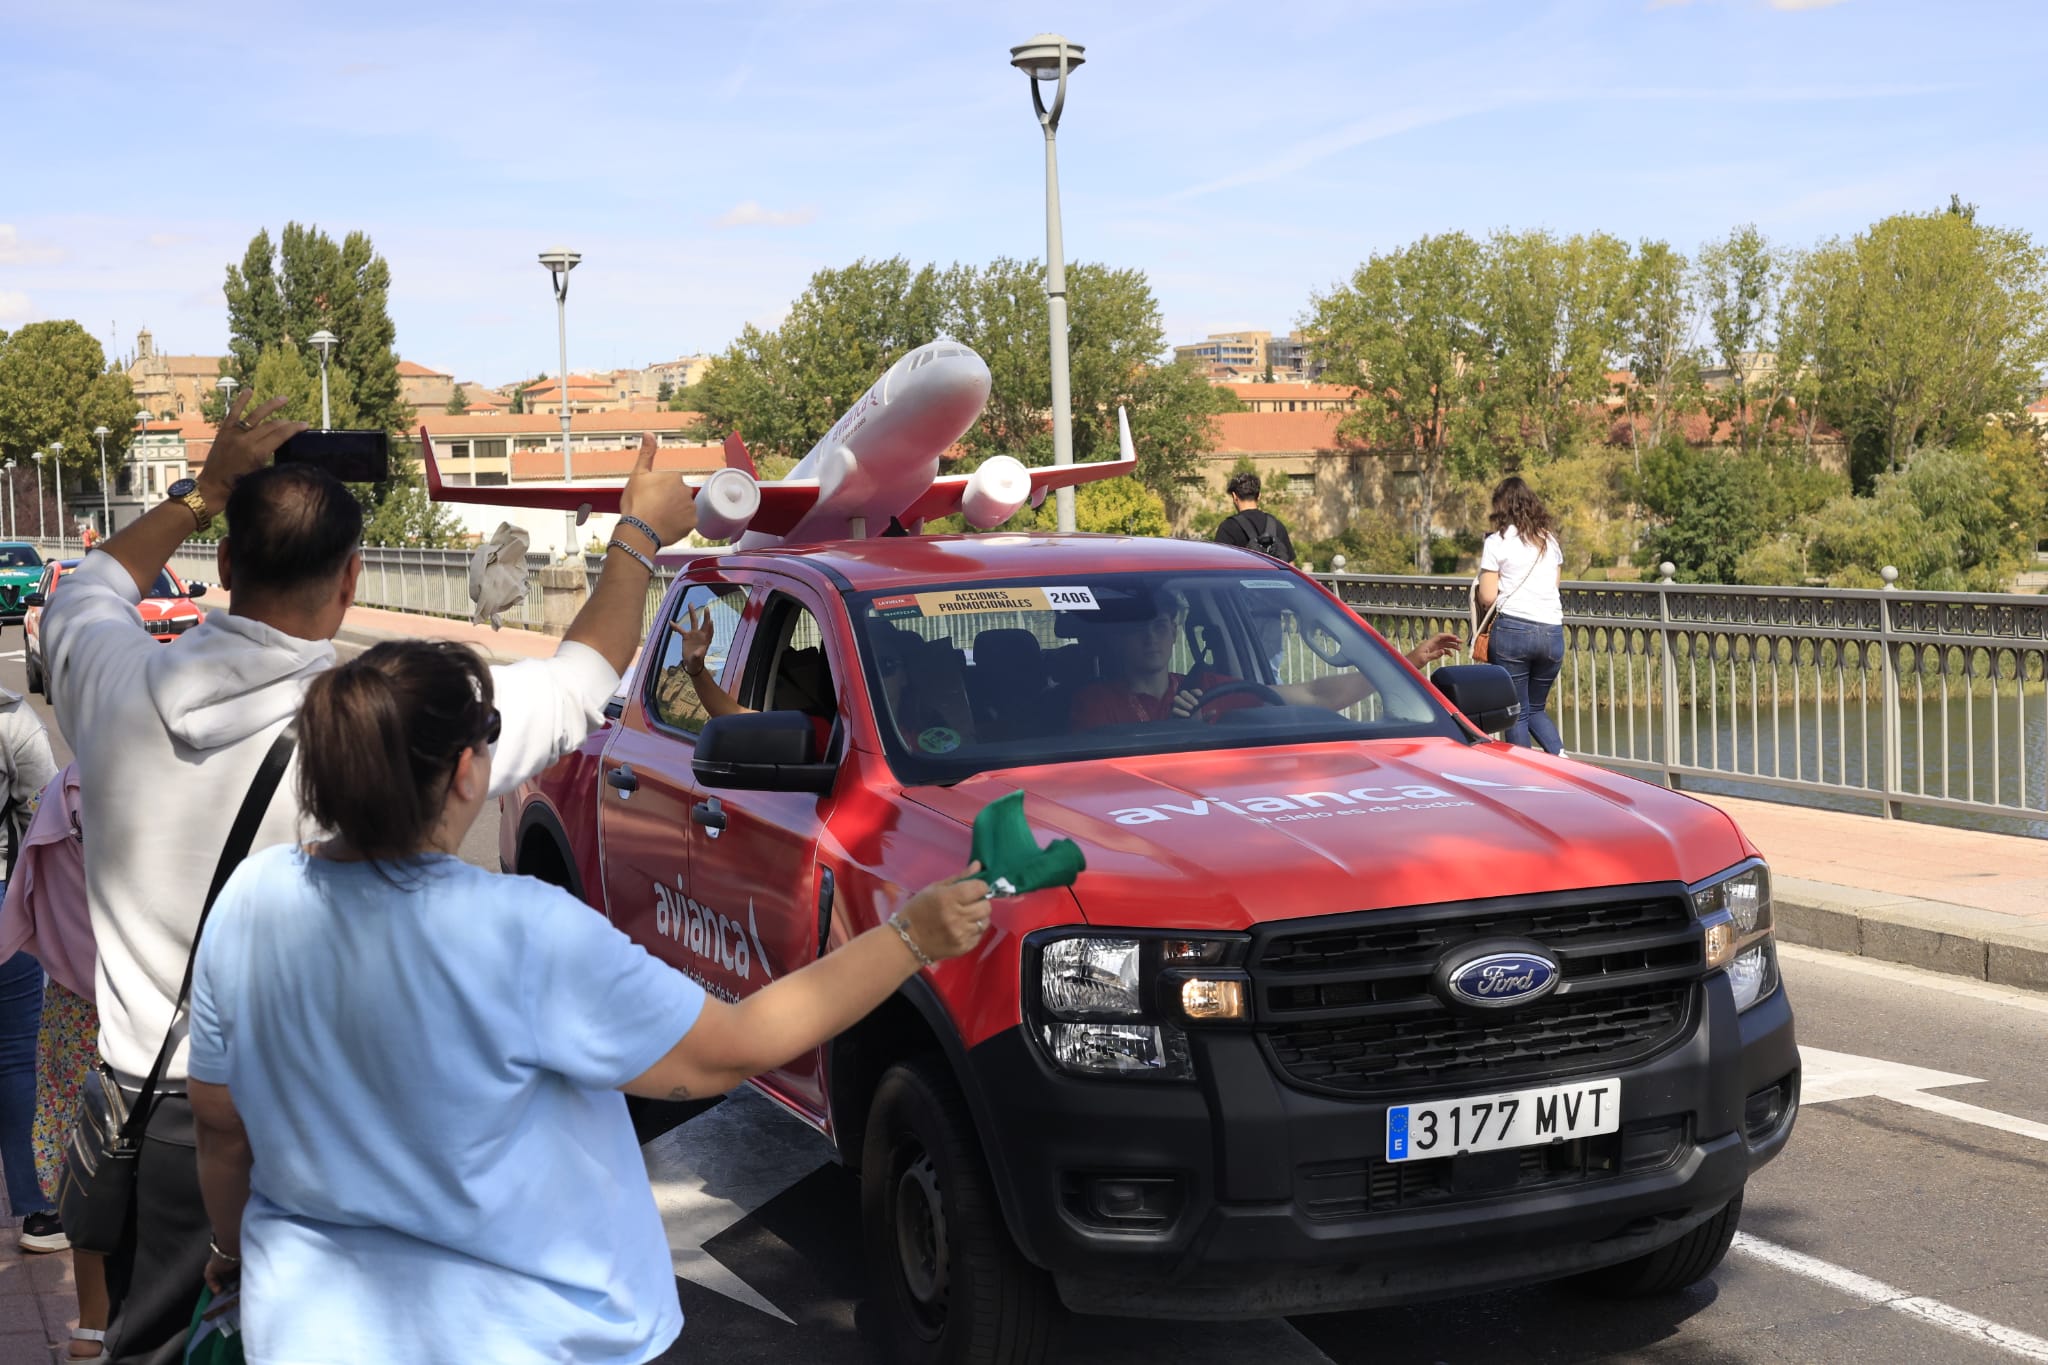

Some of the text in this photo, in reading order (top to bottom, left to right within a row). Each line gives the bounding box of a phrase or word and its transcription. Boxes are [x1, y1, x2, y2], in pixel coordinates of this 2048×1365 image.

[939, 599, 1033, 613] PROMOCIONALES
[955, 591, 1009, 602] ACCIONES
[1050, 592, 1091, 605] 2406
[1106, 782, 1456, 826] avianca
[1275, 810, 1334, 823] cielo
[1336, 808, 1367, 816] es
[1369, 805, 1401, 813] de
[1402, 800, 1476, 811] todos
[653, 873, 750, 980] avianca
[1477, 964, 1535, 995] Ford
[1415, 1087, 1609, 1151] 3177 MVT
[1394, 1138, 1403, 1151] E
